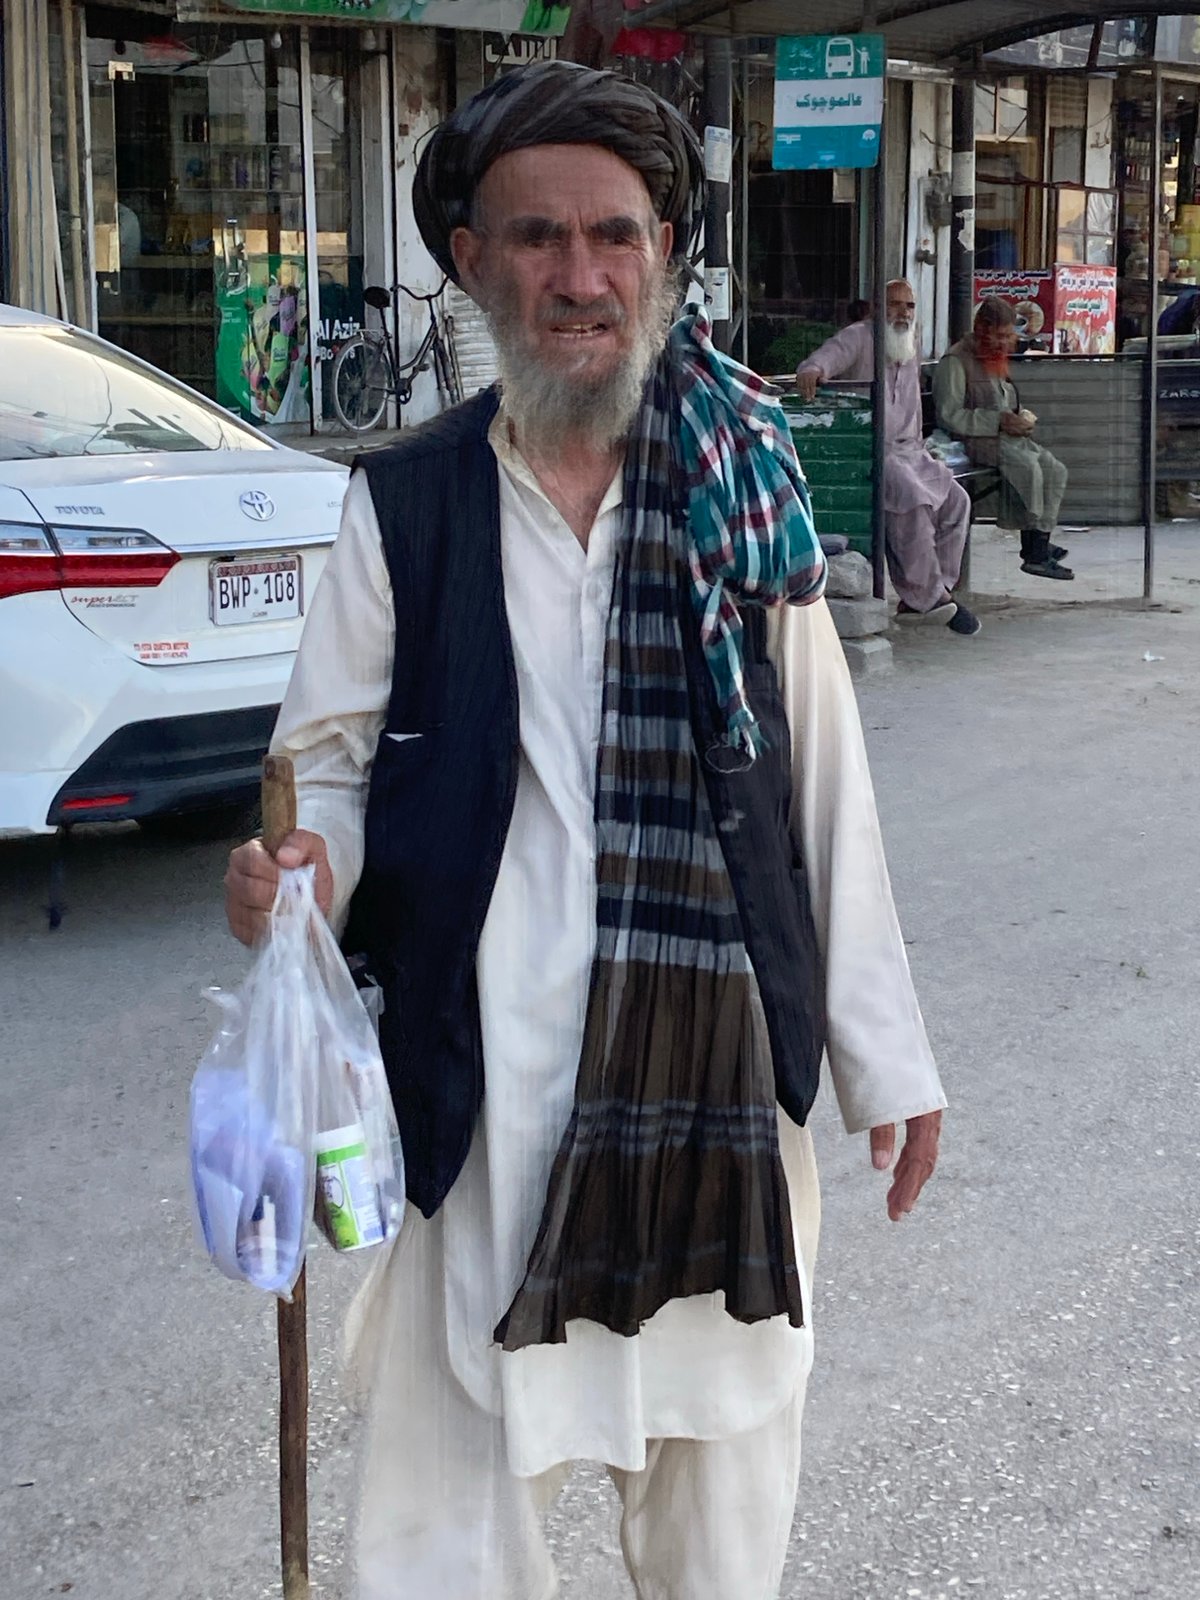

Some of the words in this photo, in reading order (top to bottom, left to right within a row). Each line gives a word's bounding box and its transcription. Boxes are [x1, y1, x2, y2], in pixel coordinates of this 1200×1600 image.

[332, 316, 360, 340] Aziz
[55, 505, 105, 515] TOYOTA
[220, 576, 251, 609] BWP
[264, 572, 295, 604] 108
